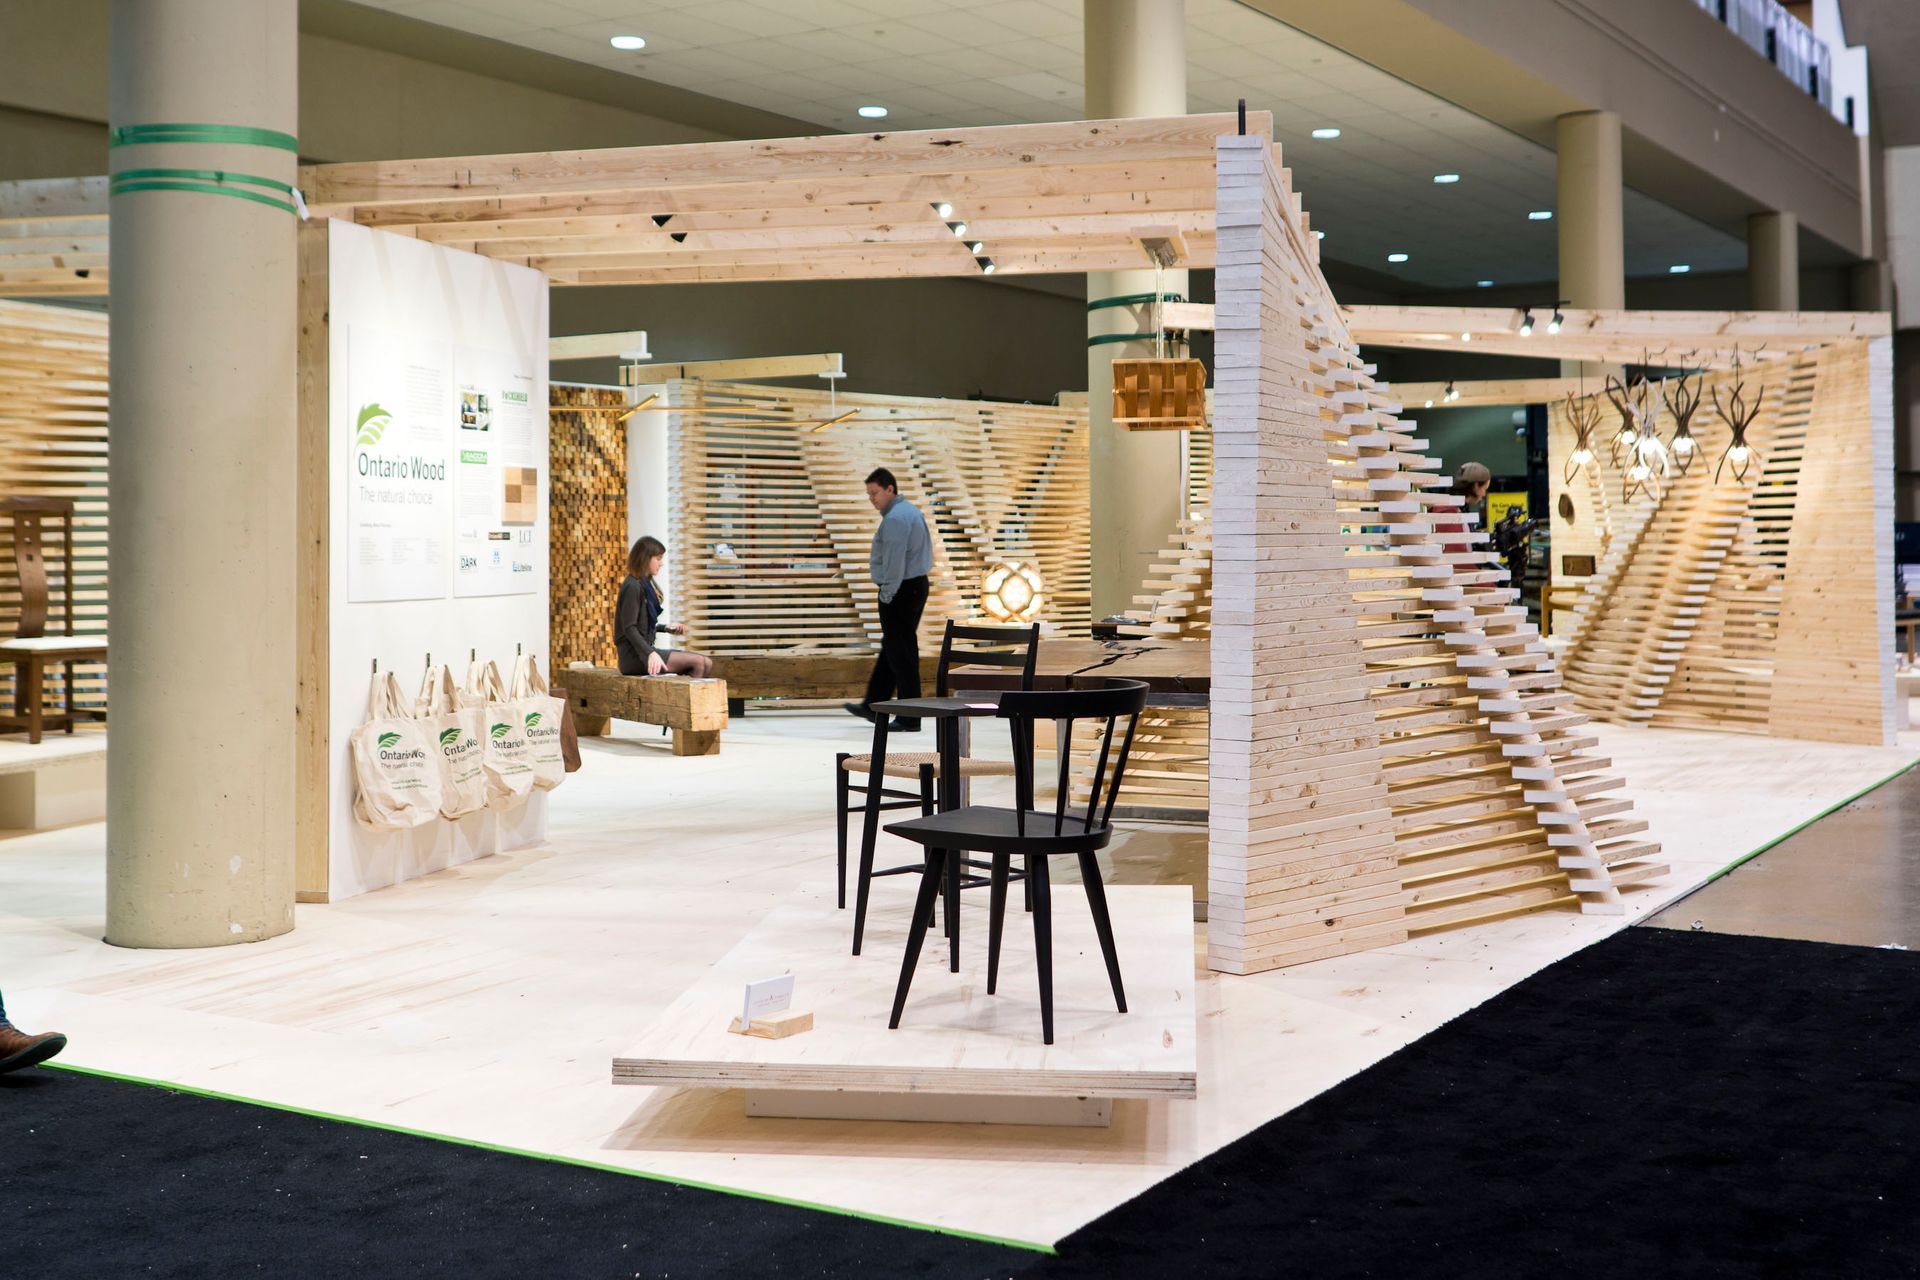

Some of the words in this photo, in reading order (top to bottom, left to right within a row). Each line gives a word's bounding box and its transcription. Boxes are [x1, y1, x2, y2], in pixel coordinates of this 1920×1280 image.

[358, 452, 408, 479] Ontario
[410, 456, 445, 481] Wood
[360, 486, 375, 502] The
[377, 488, 405, 504] natural
[407, 489, 433, 505] choice
[492, 738, 521, 749] Ontario
